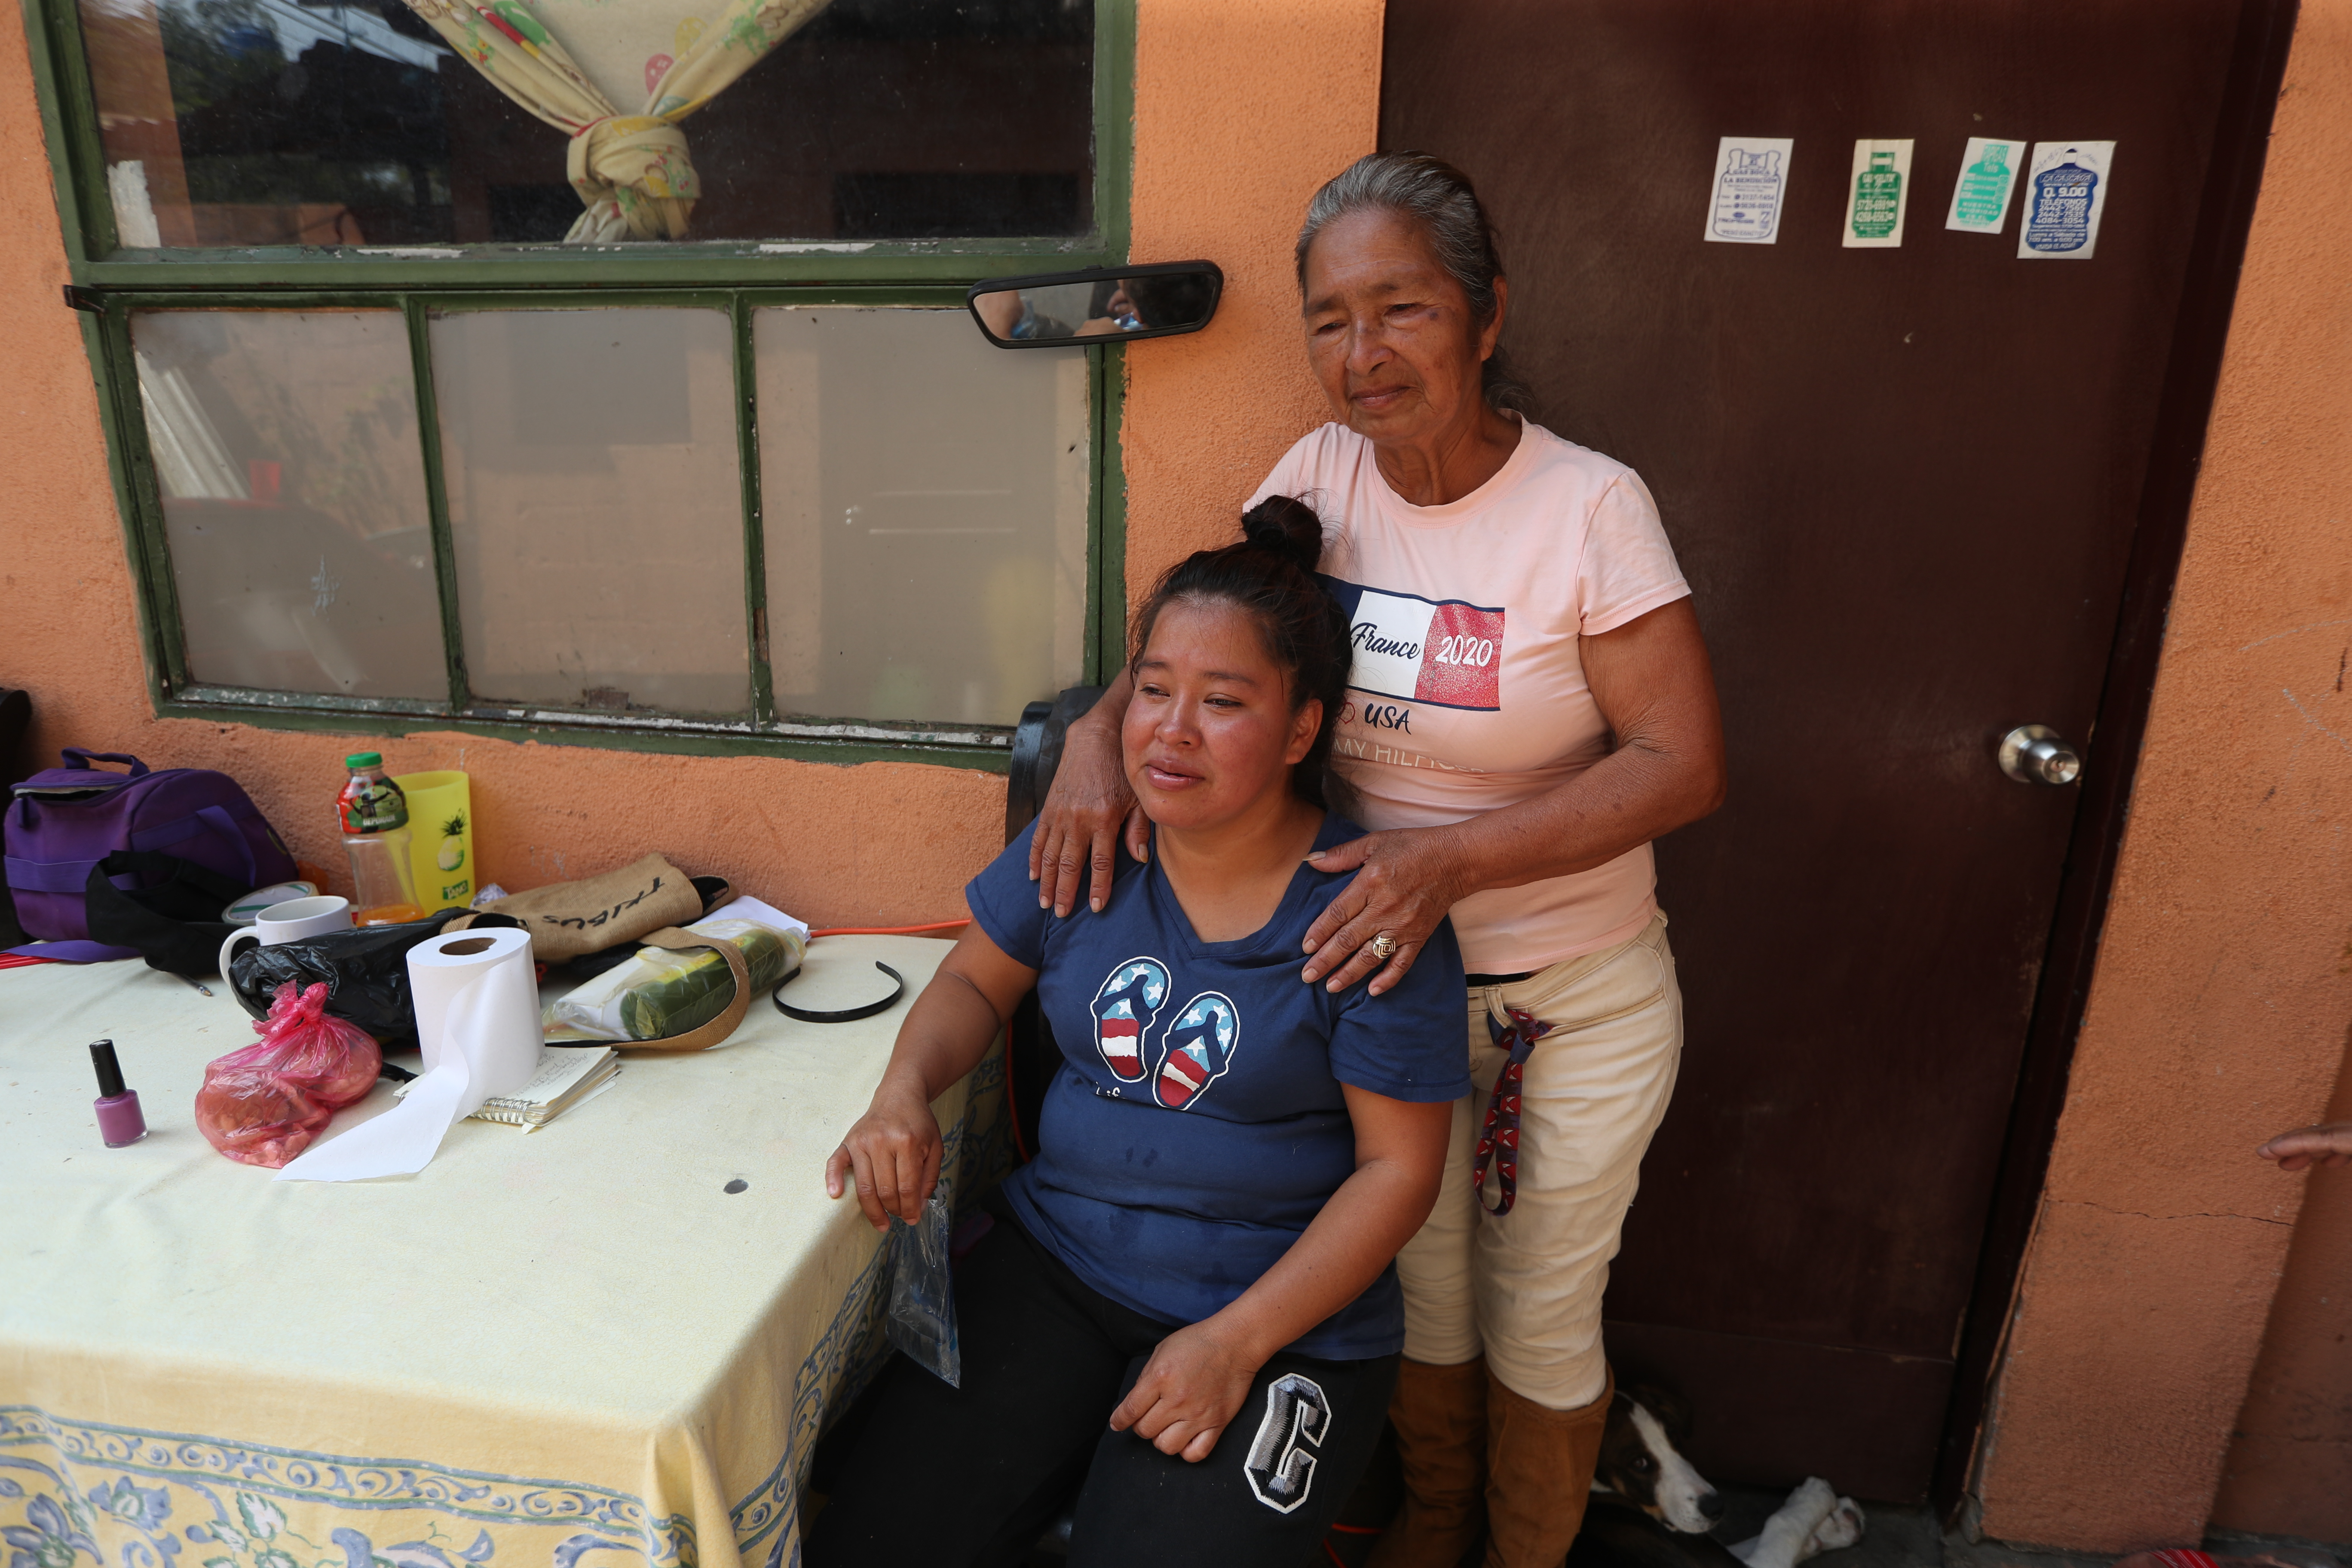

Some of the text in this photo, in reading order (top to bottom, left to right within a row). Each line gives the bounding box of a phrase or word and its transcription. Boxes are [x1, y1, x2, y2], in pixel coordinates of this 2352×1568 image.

[2043, 187, 2087, 199] Q. 9.00
[1958, 207, 1999, 215] PRIORIDAD
[1351, 622, 1493, 667] France 2020
[1364, 703, 1412, 735] USA
[542, 876, 665, 930] TRIBUS
